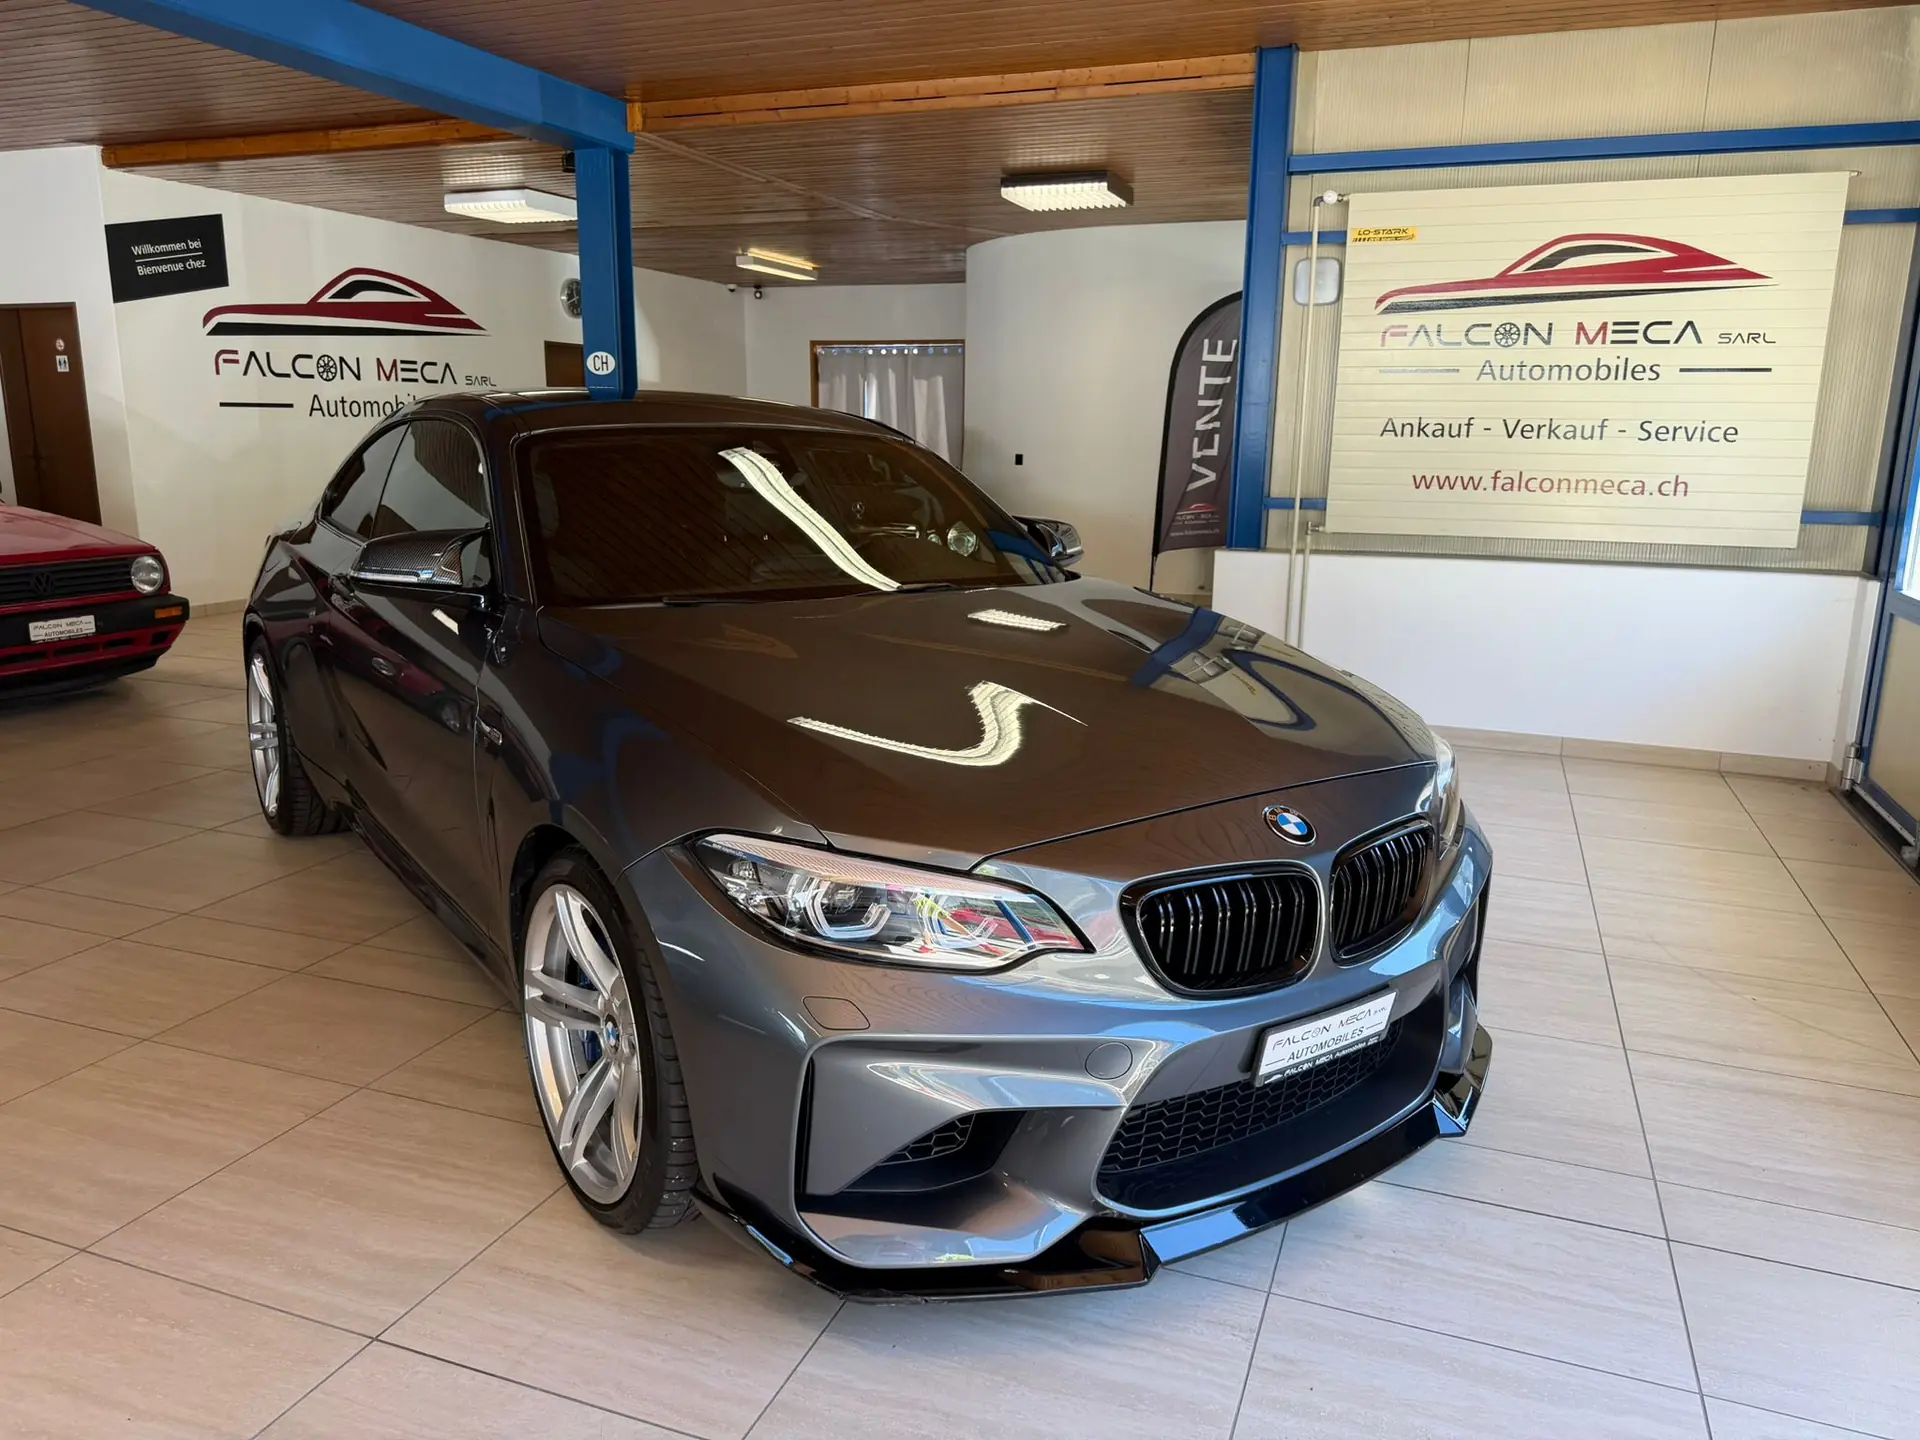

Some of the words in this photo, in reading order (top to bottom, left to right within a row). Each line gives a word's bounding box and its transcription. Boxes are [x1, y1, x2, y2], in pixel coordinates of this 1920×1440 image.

[1357, 227, 1409, 236] LO-STARK
[131, 241, 187, 256] Willkommen
[188, 238, 202, 249] bei
[137, 261, 185, 276] Bienvenue
[185, 258, 207, 270] chez
[1380, 321, 1554, 348] FALCON
[1575, 320, 1703, 345] MECA
[1717, 332, 1777, 344] SARL
[214, 349, 362, 382] FALCON
[376, 357, 458, 385] MECA
[464, 375, 497, 387] SARL
[592, 354, 609, 372] CH
[1476, 355, 1661, 382] Automobiles
[308, 393, 417, 418] Automob
[1186, 338, 1238, 492] VENTE
[1380, 416, 1475, 439] Ankauf
[1502, 418, 1610, 441] Verkauf
[1637, 419, 1739, 443] Service
[1412, 470, 1689, 497] www.falconmeca.ch
[1272, 1023, 1332, 1051] FALCON
[1337, 1008, 1372, 1029] MECA
[1286, 1025, 1365, 1064] AUTOMOBILES
[1284, 1061, 1314, 1077] FALCON
